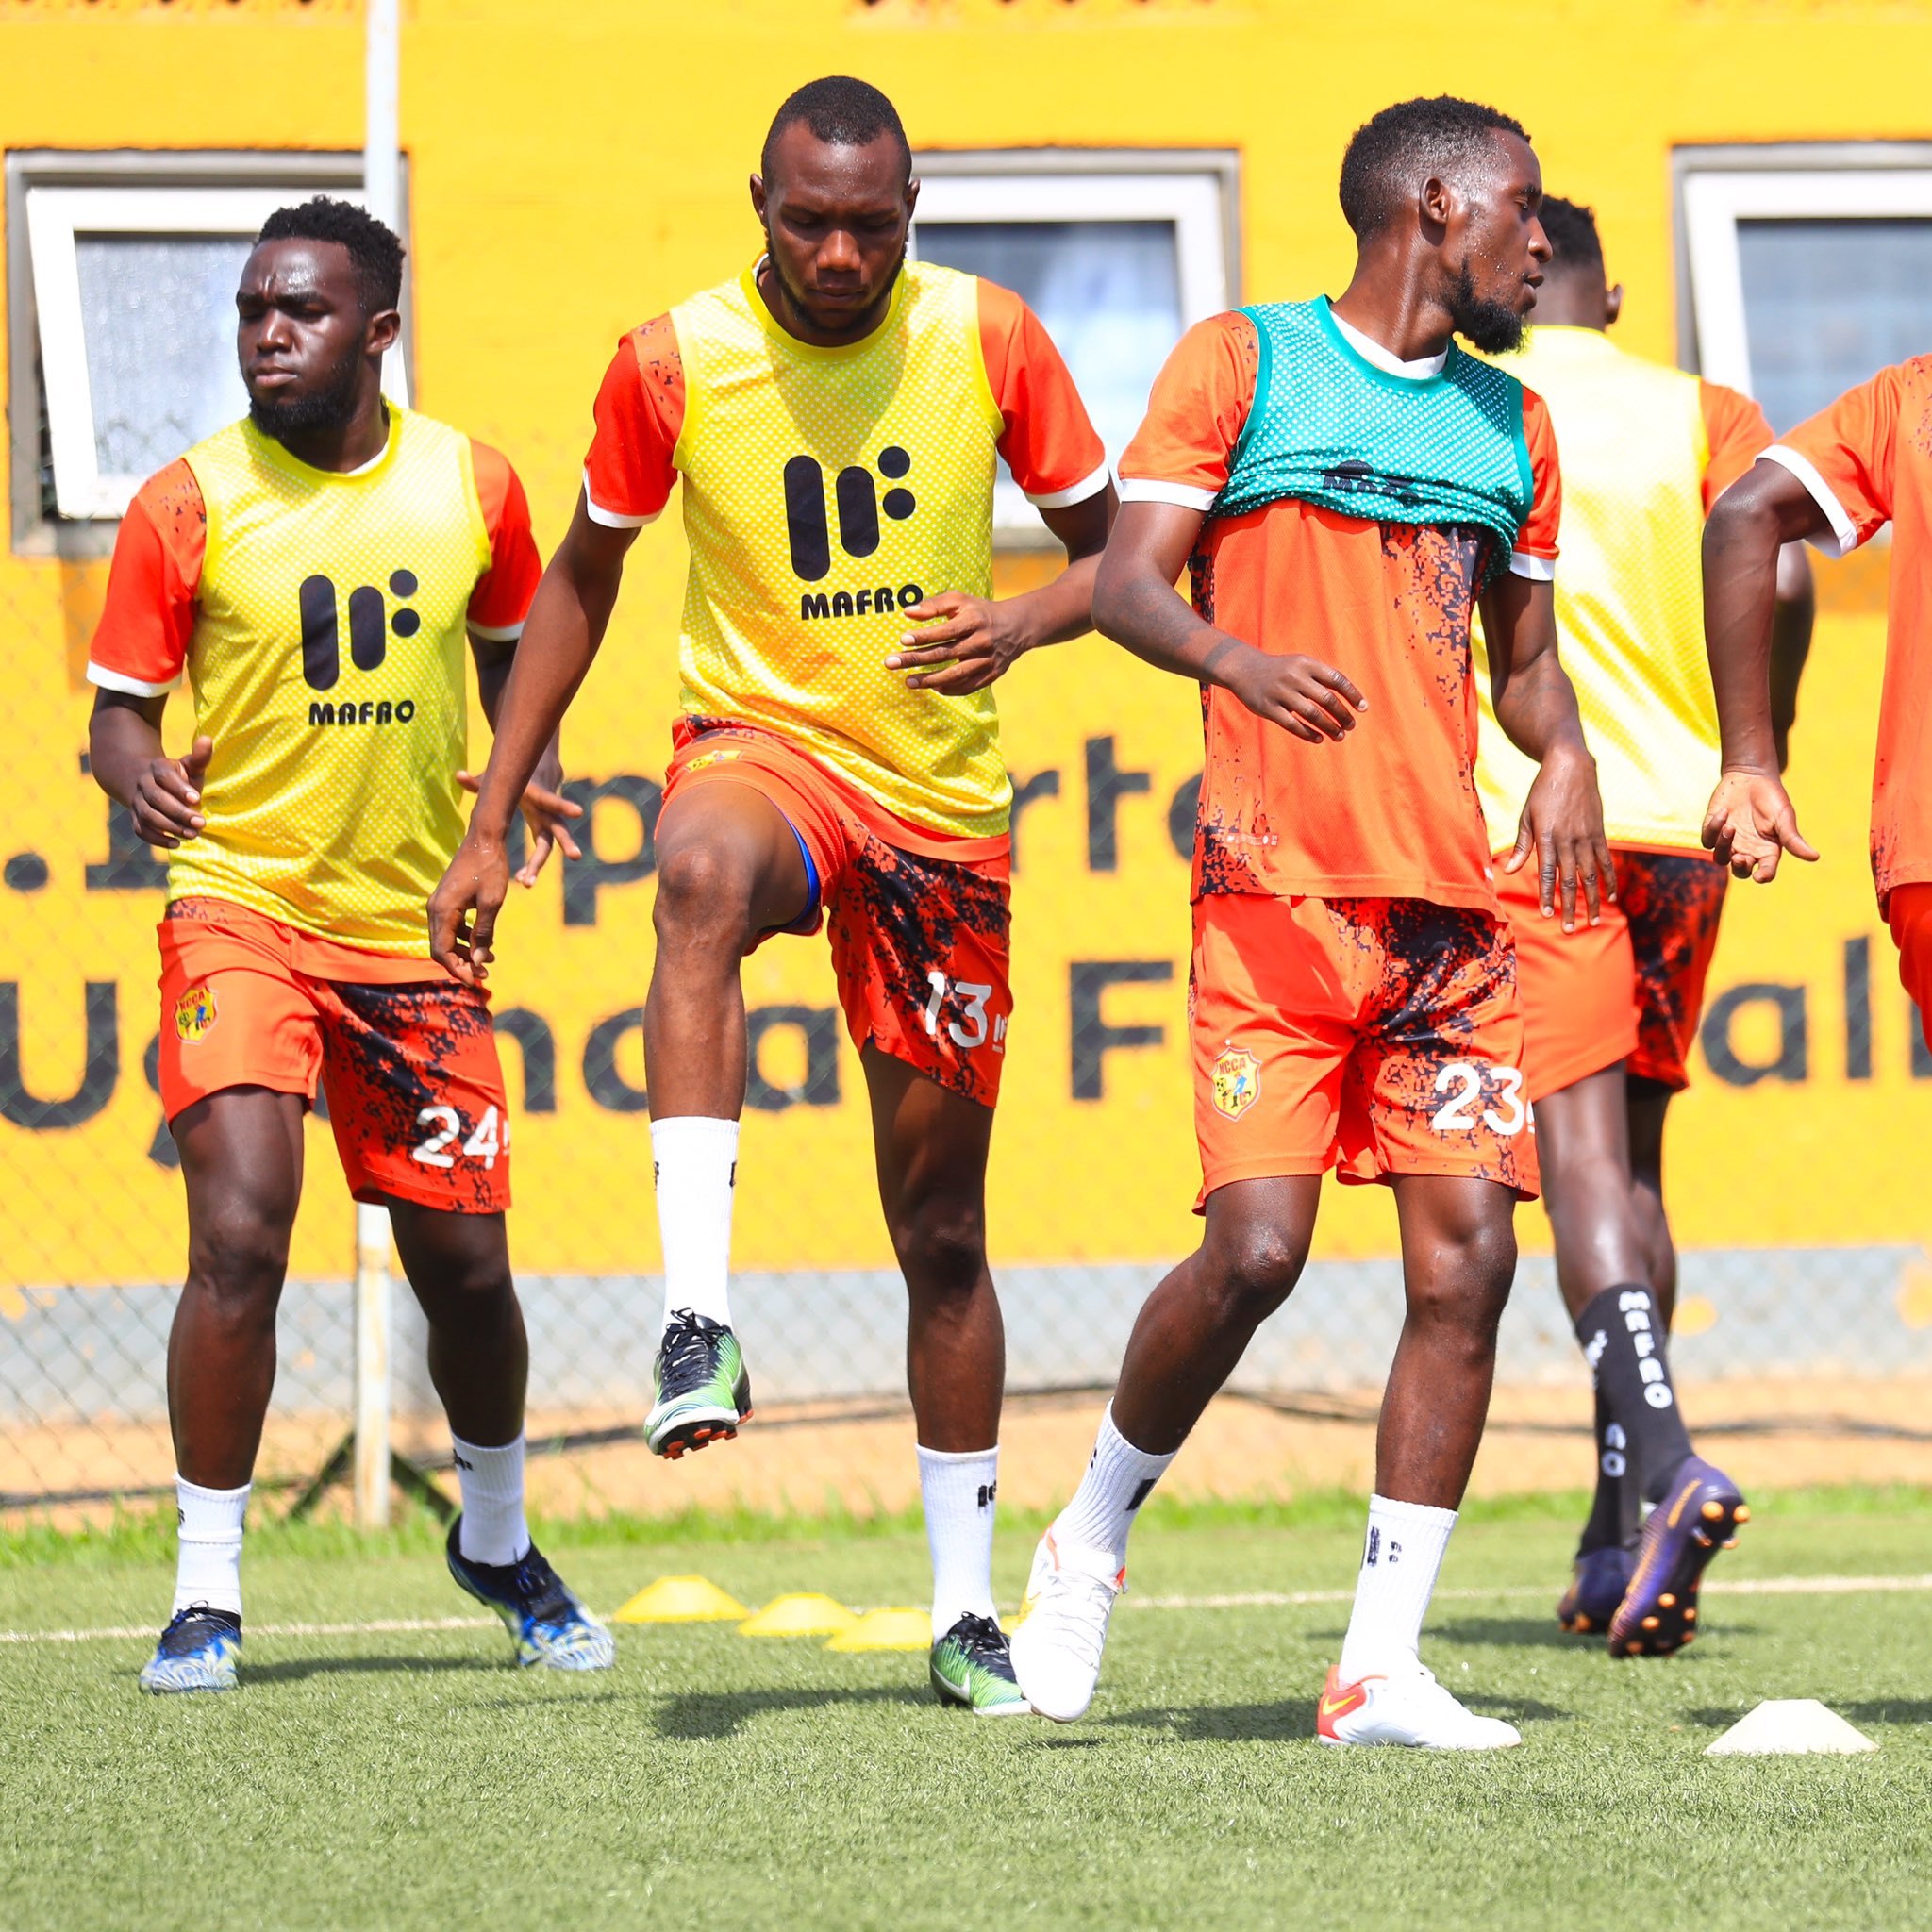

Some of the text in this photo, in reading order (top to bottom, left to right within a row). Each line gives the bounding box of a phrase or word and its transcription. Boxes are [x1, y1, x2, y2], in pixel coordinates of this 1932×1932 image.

[801, 583, 924, 622] MAFRO
[308, 699, 415, 727] MAFRO
[925, 971, 992, 1048] 13
[1219, 1057, 1247, 1075] KCCA
[1432, 1062, 1525, 1136] 23
[413, 1105, 500, 1170] 24
